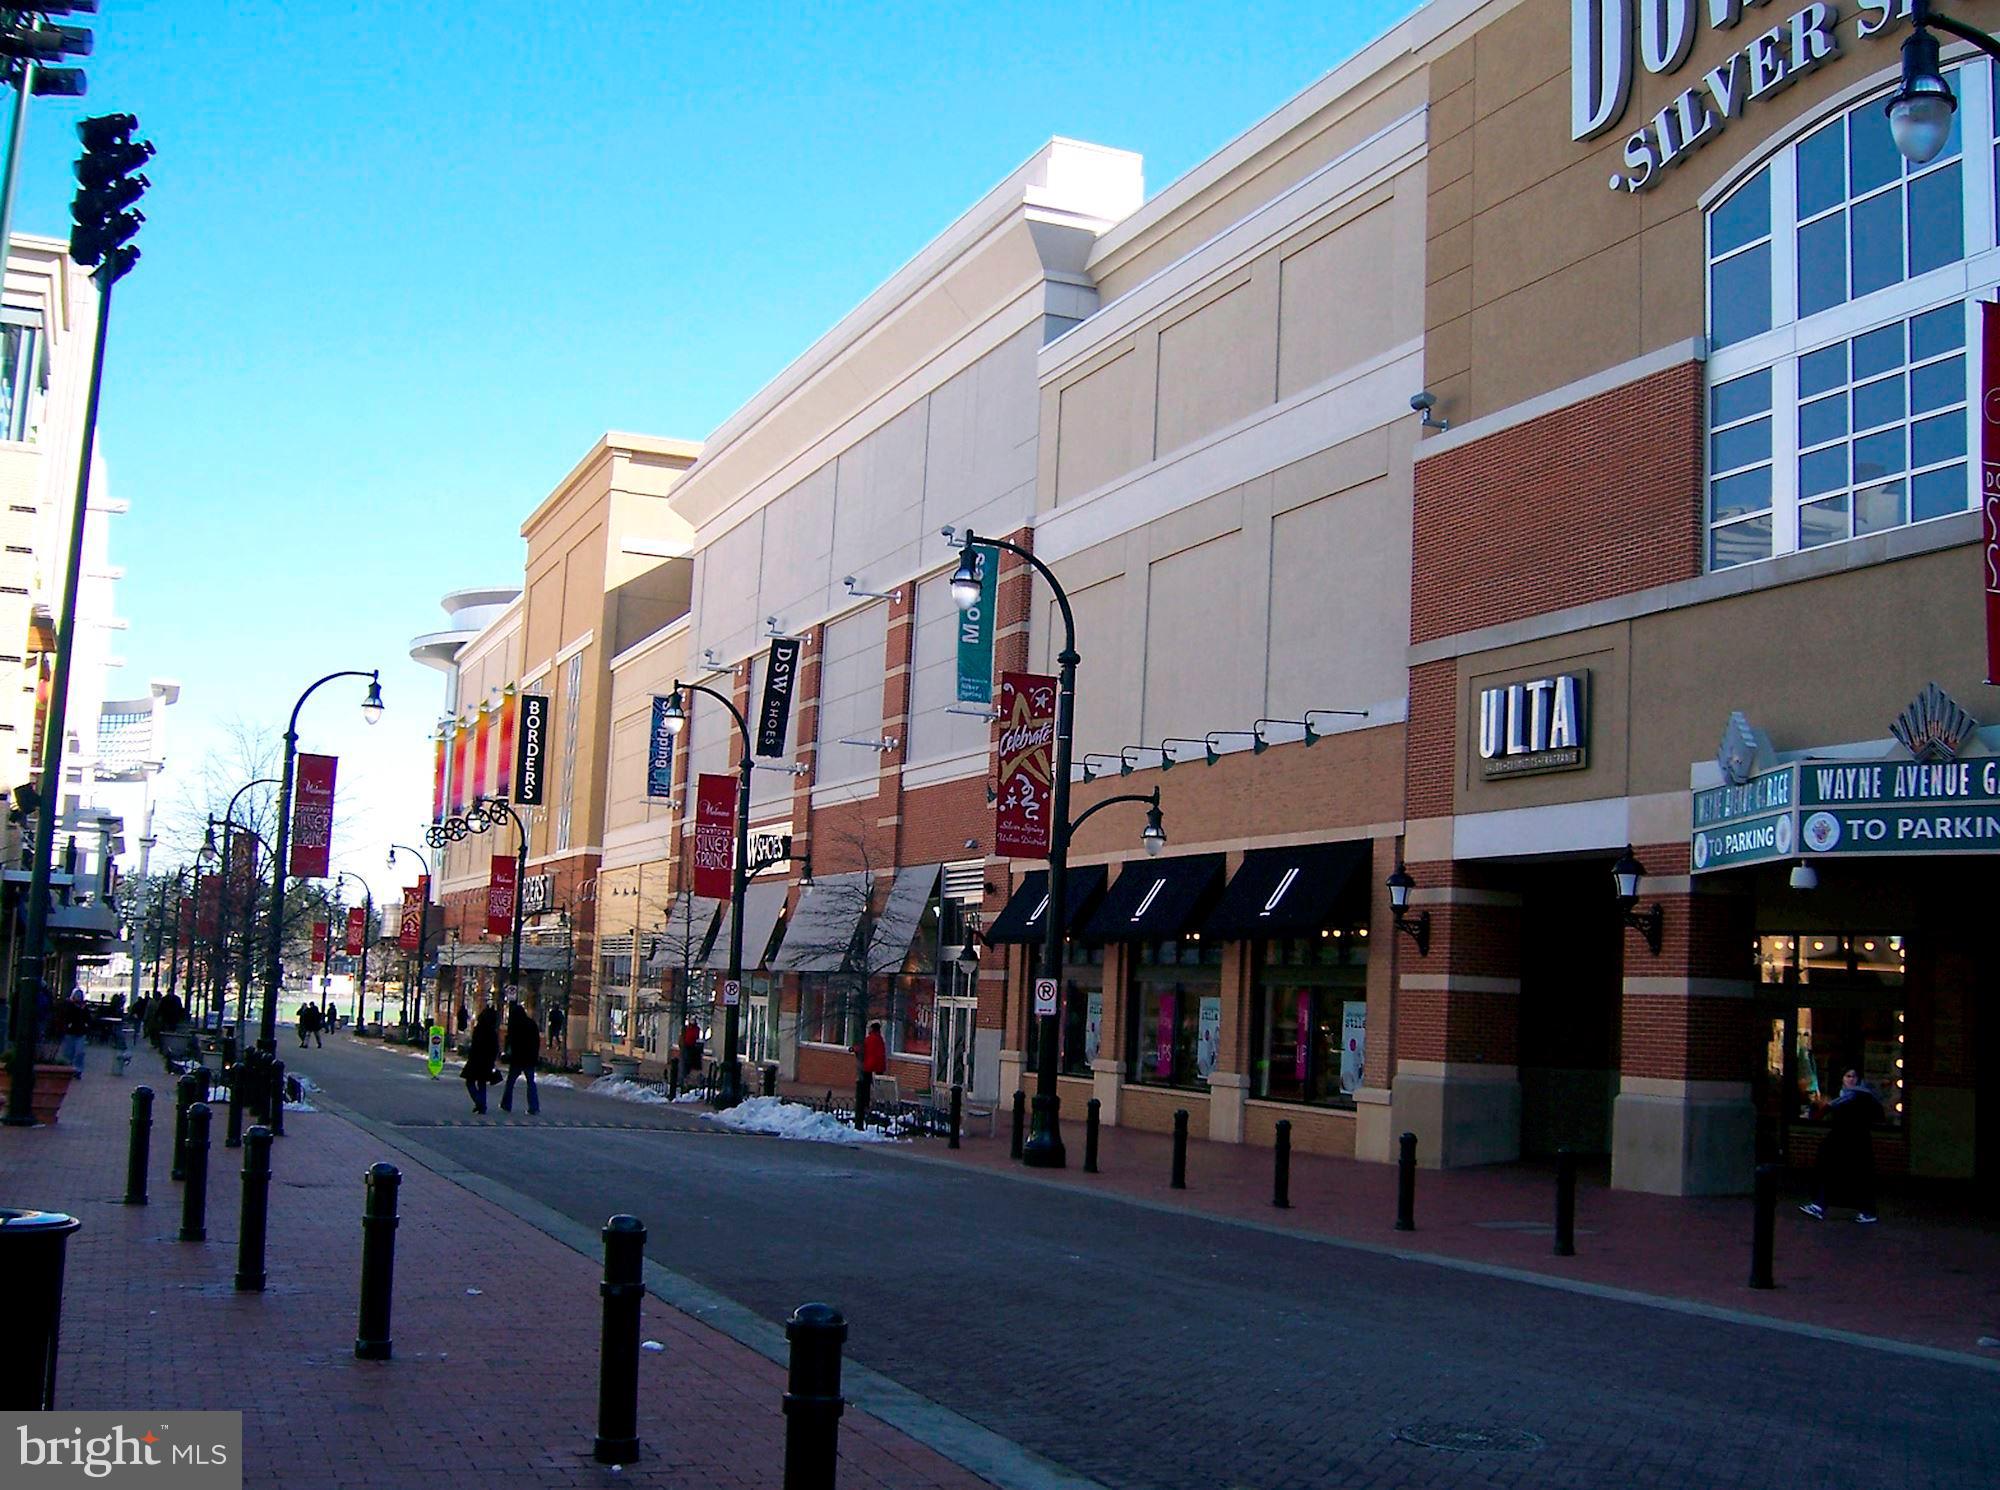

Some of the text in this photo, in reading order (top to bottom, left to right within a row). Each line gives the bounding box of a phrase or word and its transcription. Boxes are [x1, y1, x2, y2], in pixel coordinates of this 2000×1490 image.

[1624, 2, 1835, 192] SILVER
[765, 647, 793, 745] DSW SHOES
[1479, 676, 1578, 759] ULTA
[523, 700, 541, 799] BORDERS
[999, 722, 1053, 757] Celebrate
[1817, 767, 1882, 800] WAYNE
[1894, 762, 1969, 798] AVENUE
[696, 836, 729, 853] SILVER
[1707, 826, 1775, 857] TO PARKING
[1846, 818, 1887, 841] TO
[694, 852, 728, 868] SPRING
